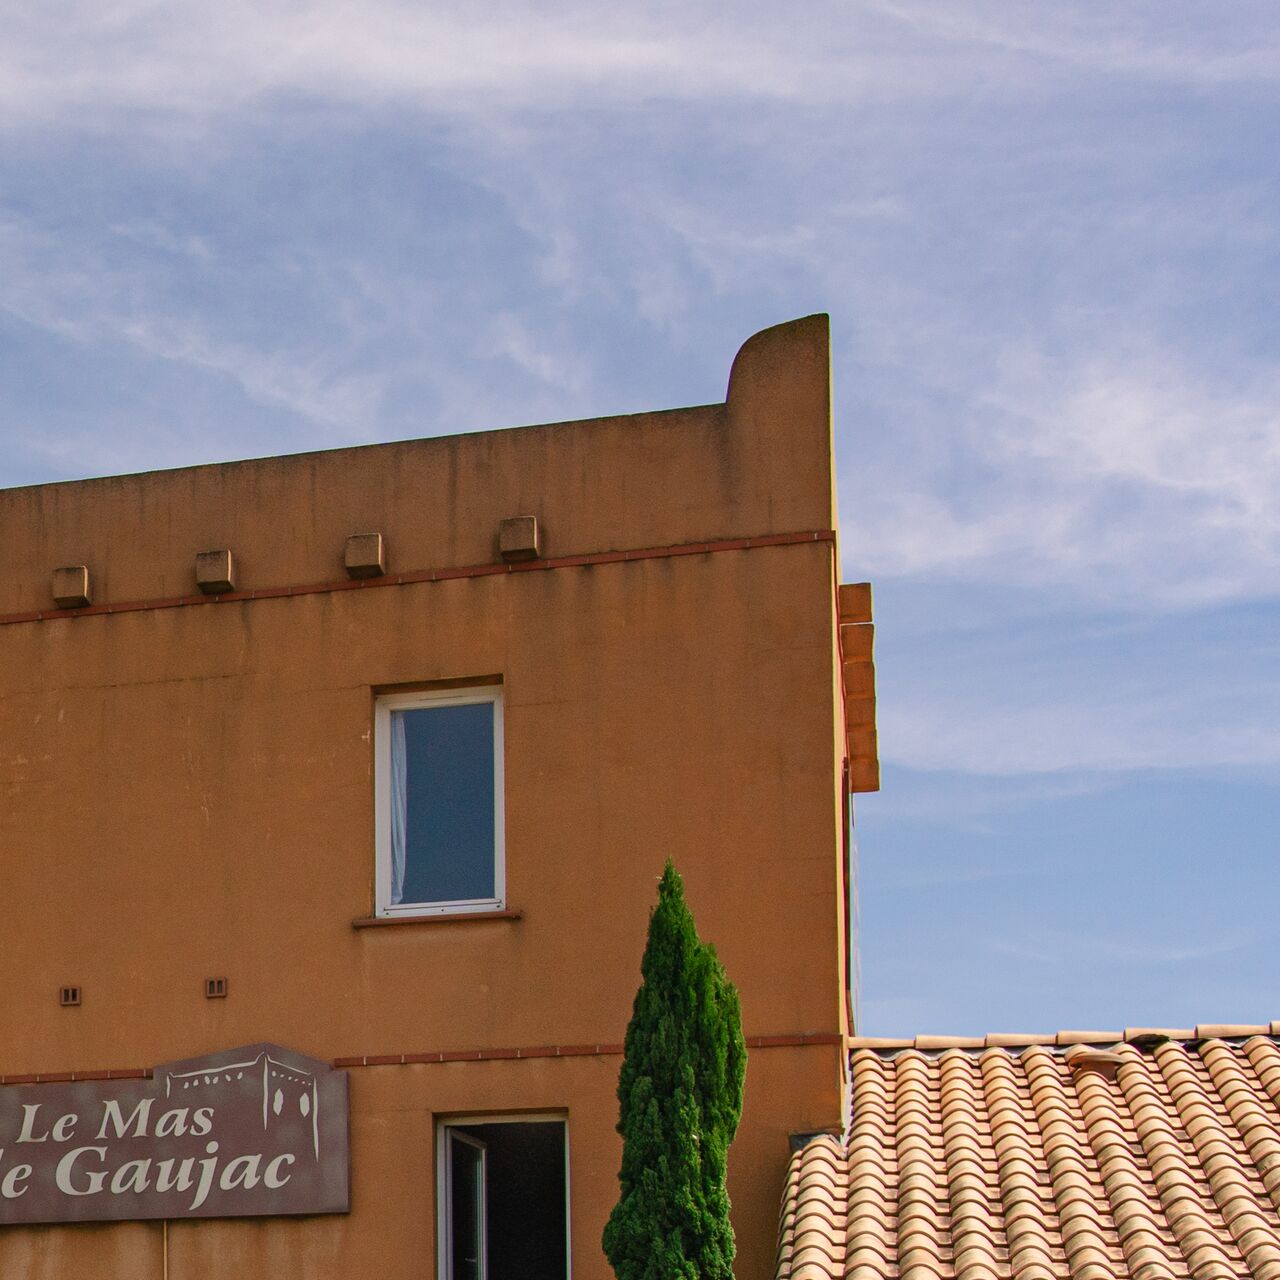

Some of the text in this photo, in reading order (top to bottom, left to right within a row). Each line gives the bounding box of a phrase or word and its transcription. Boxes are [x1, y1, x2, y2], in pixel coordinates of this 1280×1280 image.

[15, 1098, 216, 1144] Le Mas
[54, 1140, 297, 1211] Gaujac
